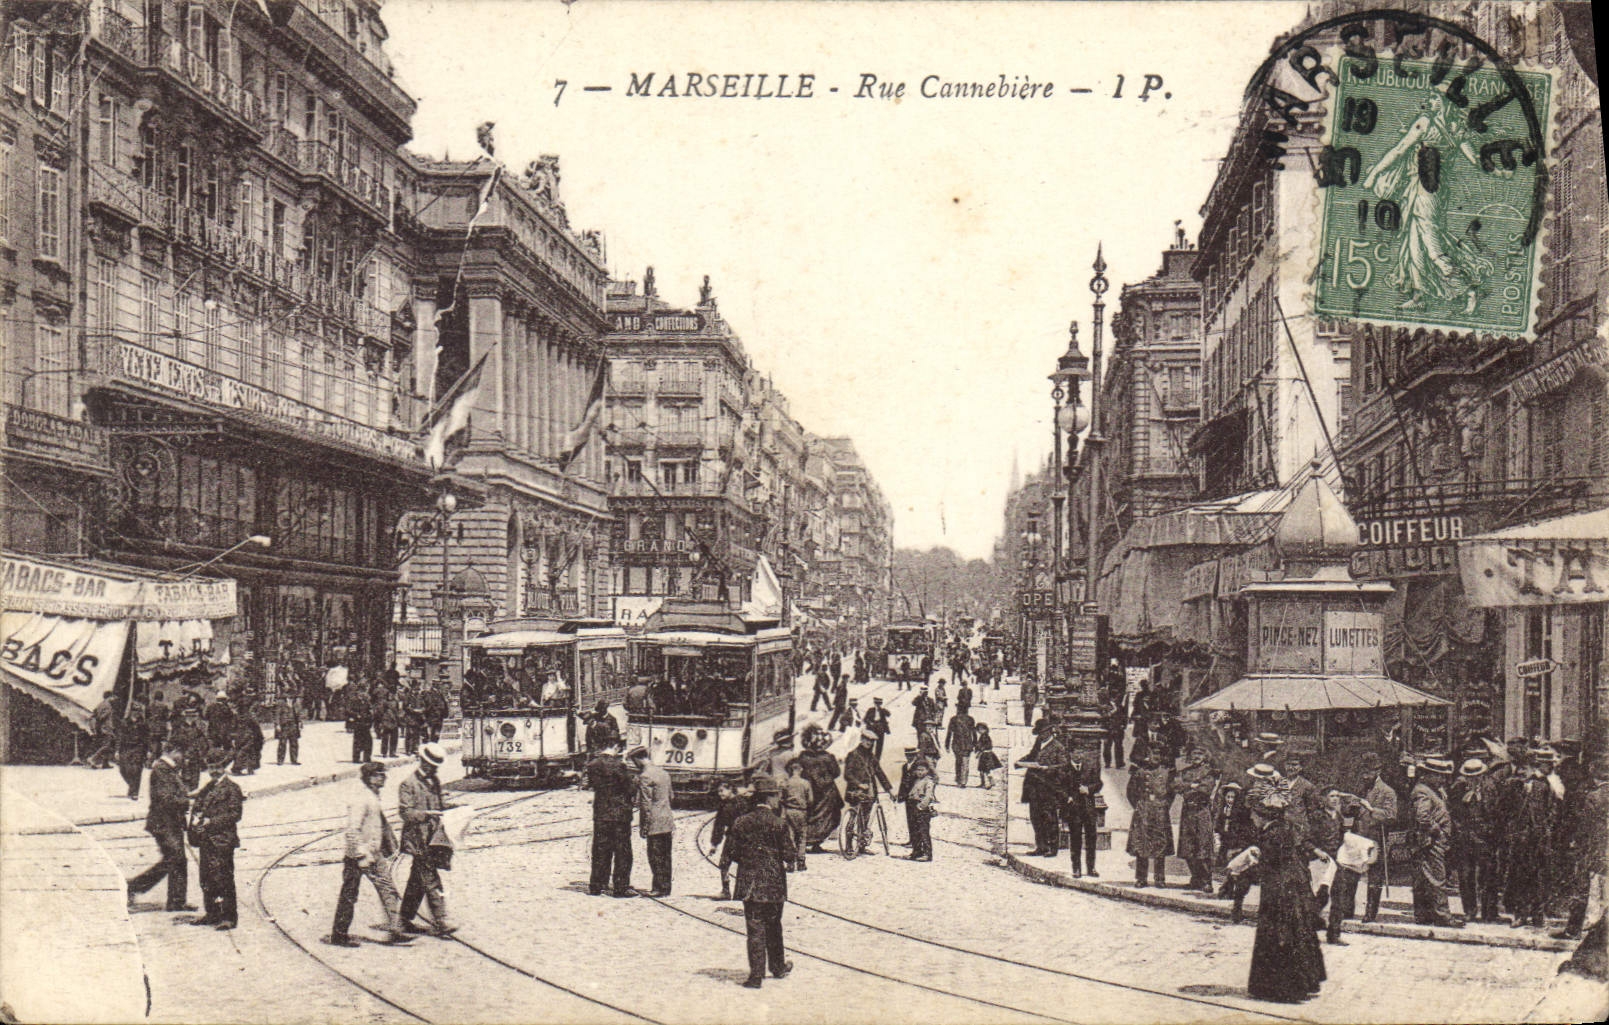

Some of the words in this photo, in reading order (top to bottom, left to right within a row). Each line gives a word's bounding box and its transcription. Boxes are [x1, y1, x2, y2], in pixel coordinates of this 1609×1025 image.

[1502, 233, 1525, 315] POSTES
[1357, 516, 1463, 546] COIFFEUR
[1330, 627, 1379, 648] LUNETTES
[498, 741, 523, 753] 732
[665, 751, 695, 764] 708
